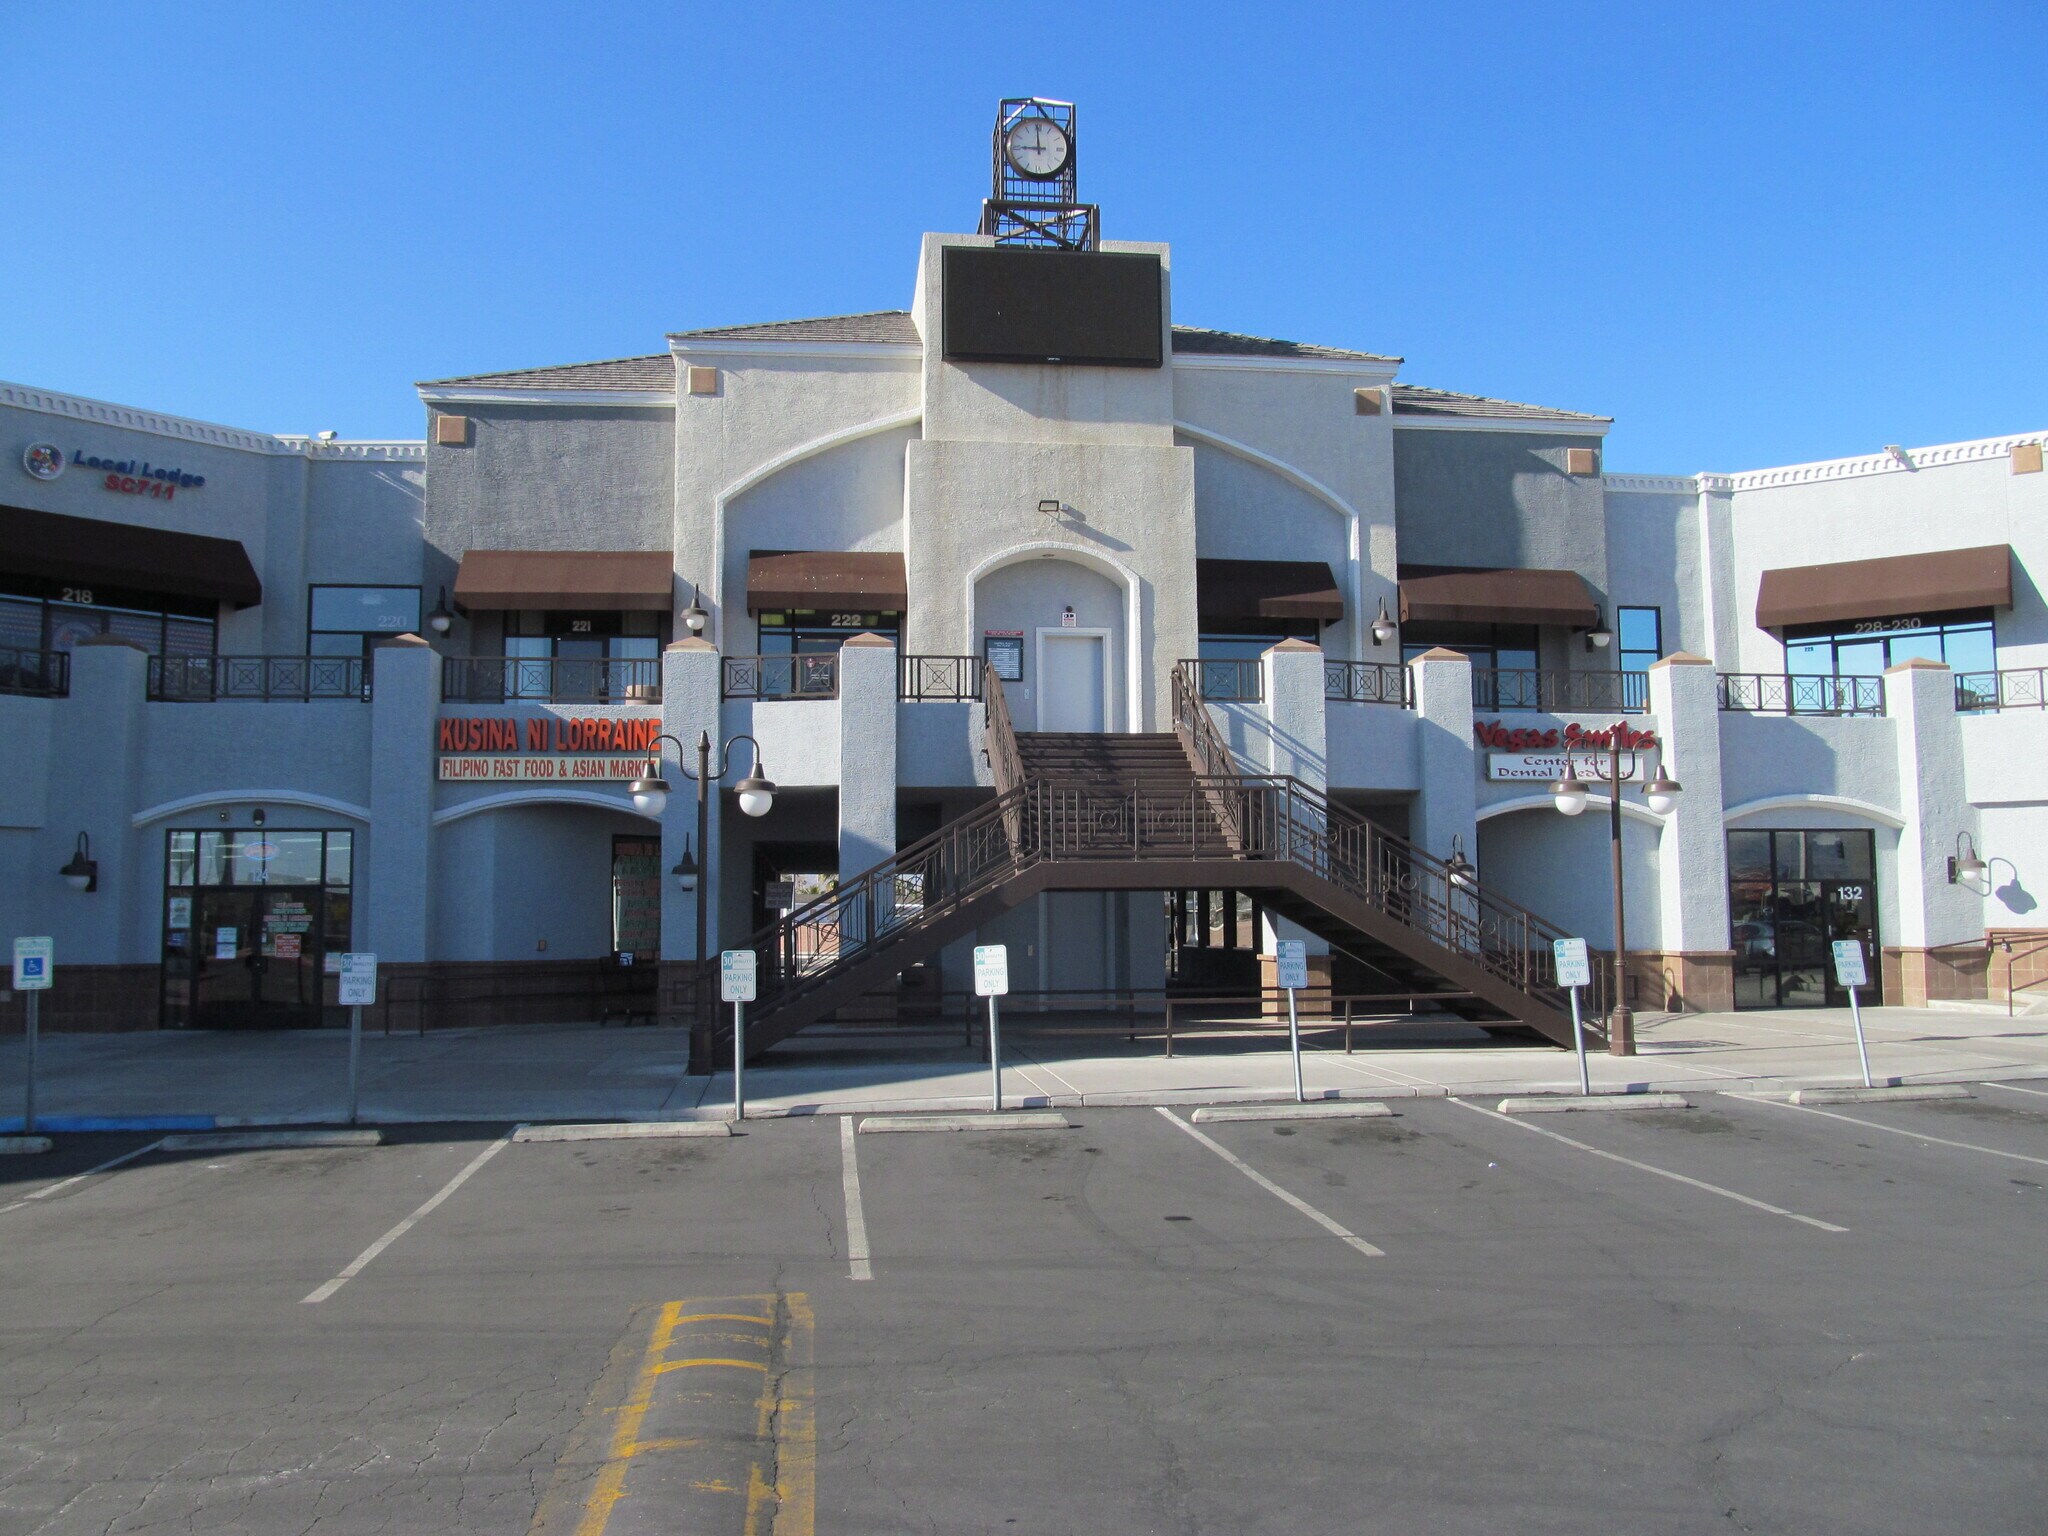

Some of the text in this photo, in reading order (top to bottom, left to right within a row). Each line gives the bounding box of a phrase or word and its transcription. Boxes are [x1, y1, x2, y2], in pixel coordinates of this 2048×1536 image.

[73, 449, 206, 488] Local Lodge
[104, 473, 176, 500] SC711
[62, 587, 93, 603] 218
[378, 615, 408, 628] 220
[831, 614, 862, 626] 222
[572, 620, 591, 632] 221
[1855, 617, 1921, 635] 228-230
[440, 716, 661, 751] KUSINA NI LORRAINE
[1474, 719, 1559, 753] Vegas
[1584, 755, 1607, 766] for
[443, 759, 657, 778] FILIPINO FAST FOOD & ASIAN MARK
[1497, 767, 1553, 776] Dental
[1838, 886, 1863, 900] 132
[1278, 945, 1285, 955] 30
[1556, 944, 1565, 954] 30
[723, 956, 733, 966] 30
[976, 951, 985, 962] 30
[343, 958, 352, 968] 30
[1279, 961, 1304, 970] PARKING
[1560, 959, 1585, 969] PARKING
[977, 967, 1004, 977] PARKING
[1285, 972, 1299, 981] ONLY
[1565, 970, 1581, 979] ONLY
[343, 976, 374, 985] PARKING
[725, 973, 753, 982] PARKING
[984, 979, 999, 988] ONLY
[347, 988, 367, 998] ONLY
[730, 985, 748, 994] ONLY
